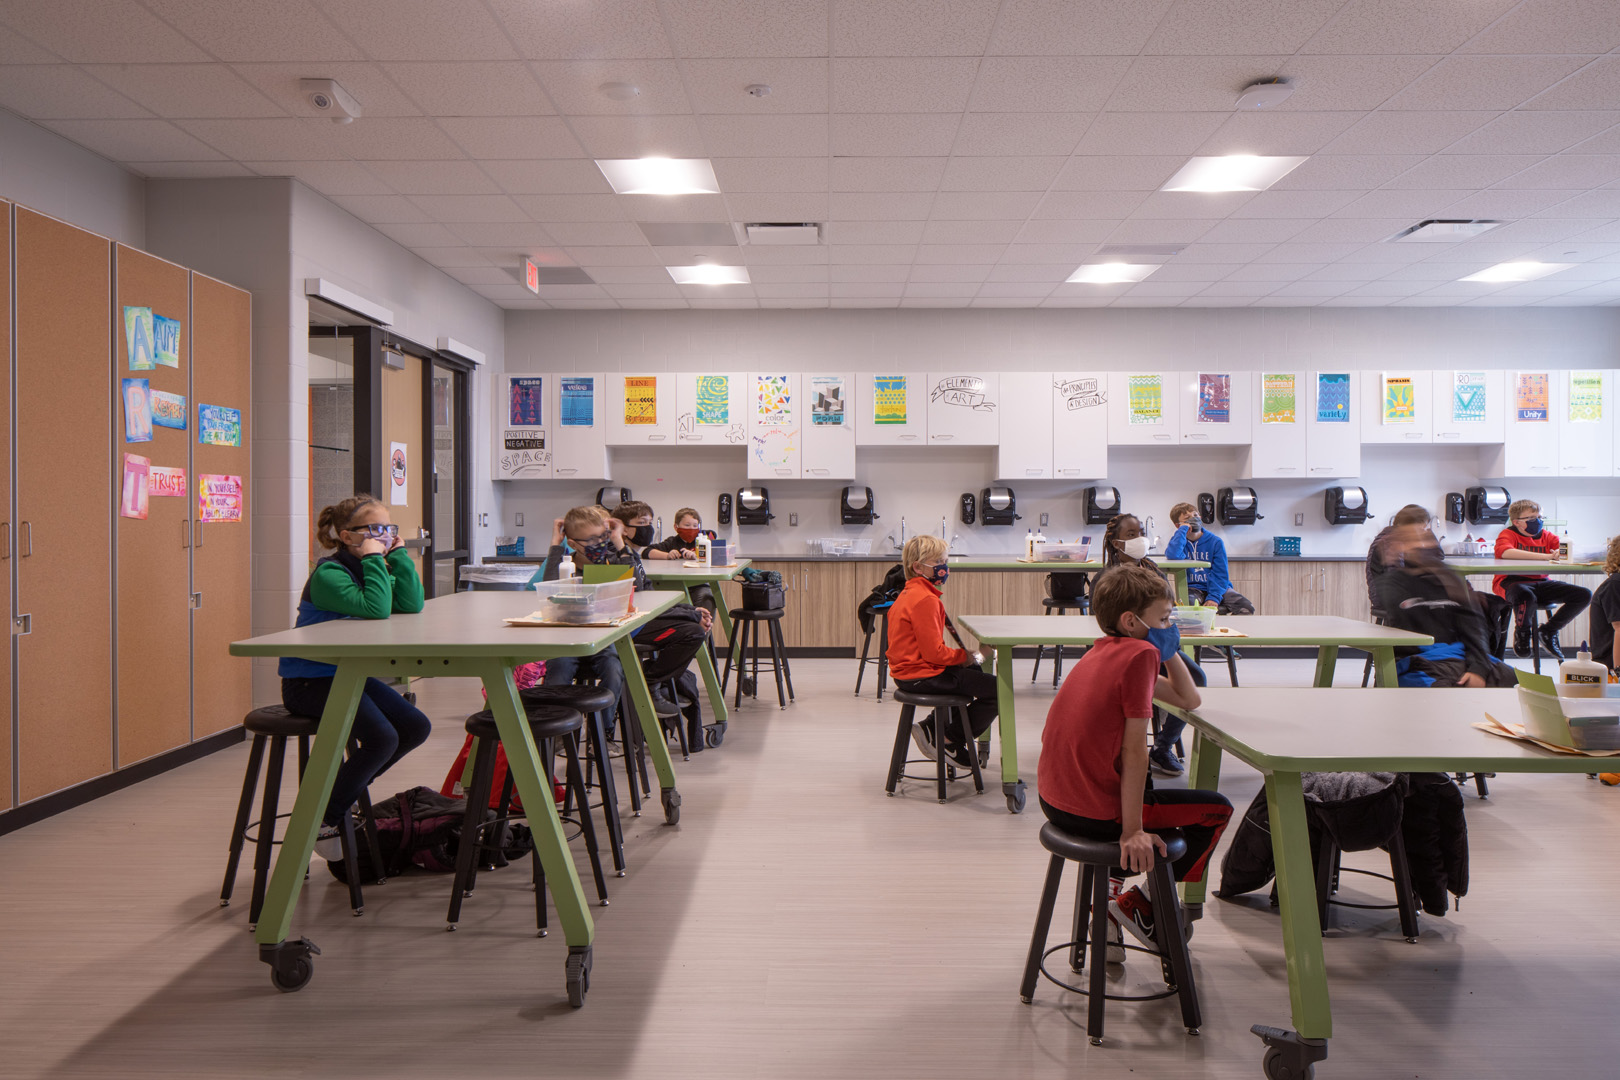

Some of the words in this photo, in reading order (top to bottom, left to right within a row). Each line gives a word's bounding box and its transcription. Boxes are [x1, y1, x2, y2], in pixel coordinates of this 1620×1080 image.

[133, 315, 152, 362] A
[154, 321, 177, 358] AIM
[951, 392, 976, 405] ART
[1074, 397, 1099, 407] DESIGN
[128, 386, 149, 436] R
[154, 396, 186, 422] RESPECT
[765, 413, 784, 421] color
[1319, 411, 1346, 420] variety
[1523, 410, 1542, 419] Unity
[507, 440, 543, 448] NEGATIVE
[501, 451, 552, 471] SPACE
[127, 461, 147, 511] T
[153, 472, 182, 492] TRUST
[1571, 675, 1594, 683] BLICK
